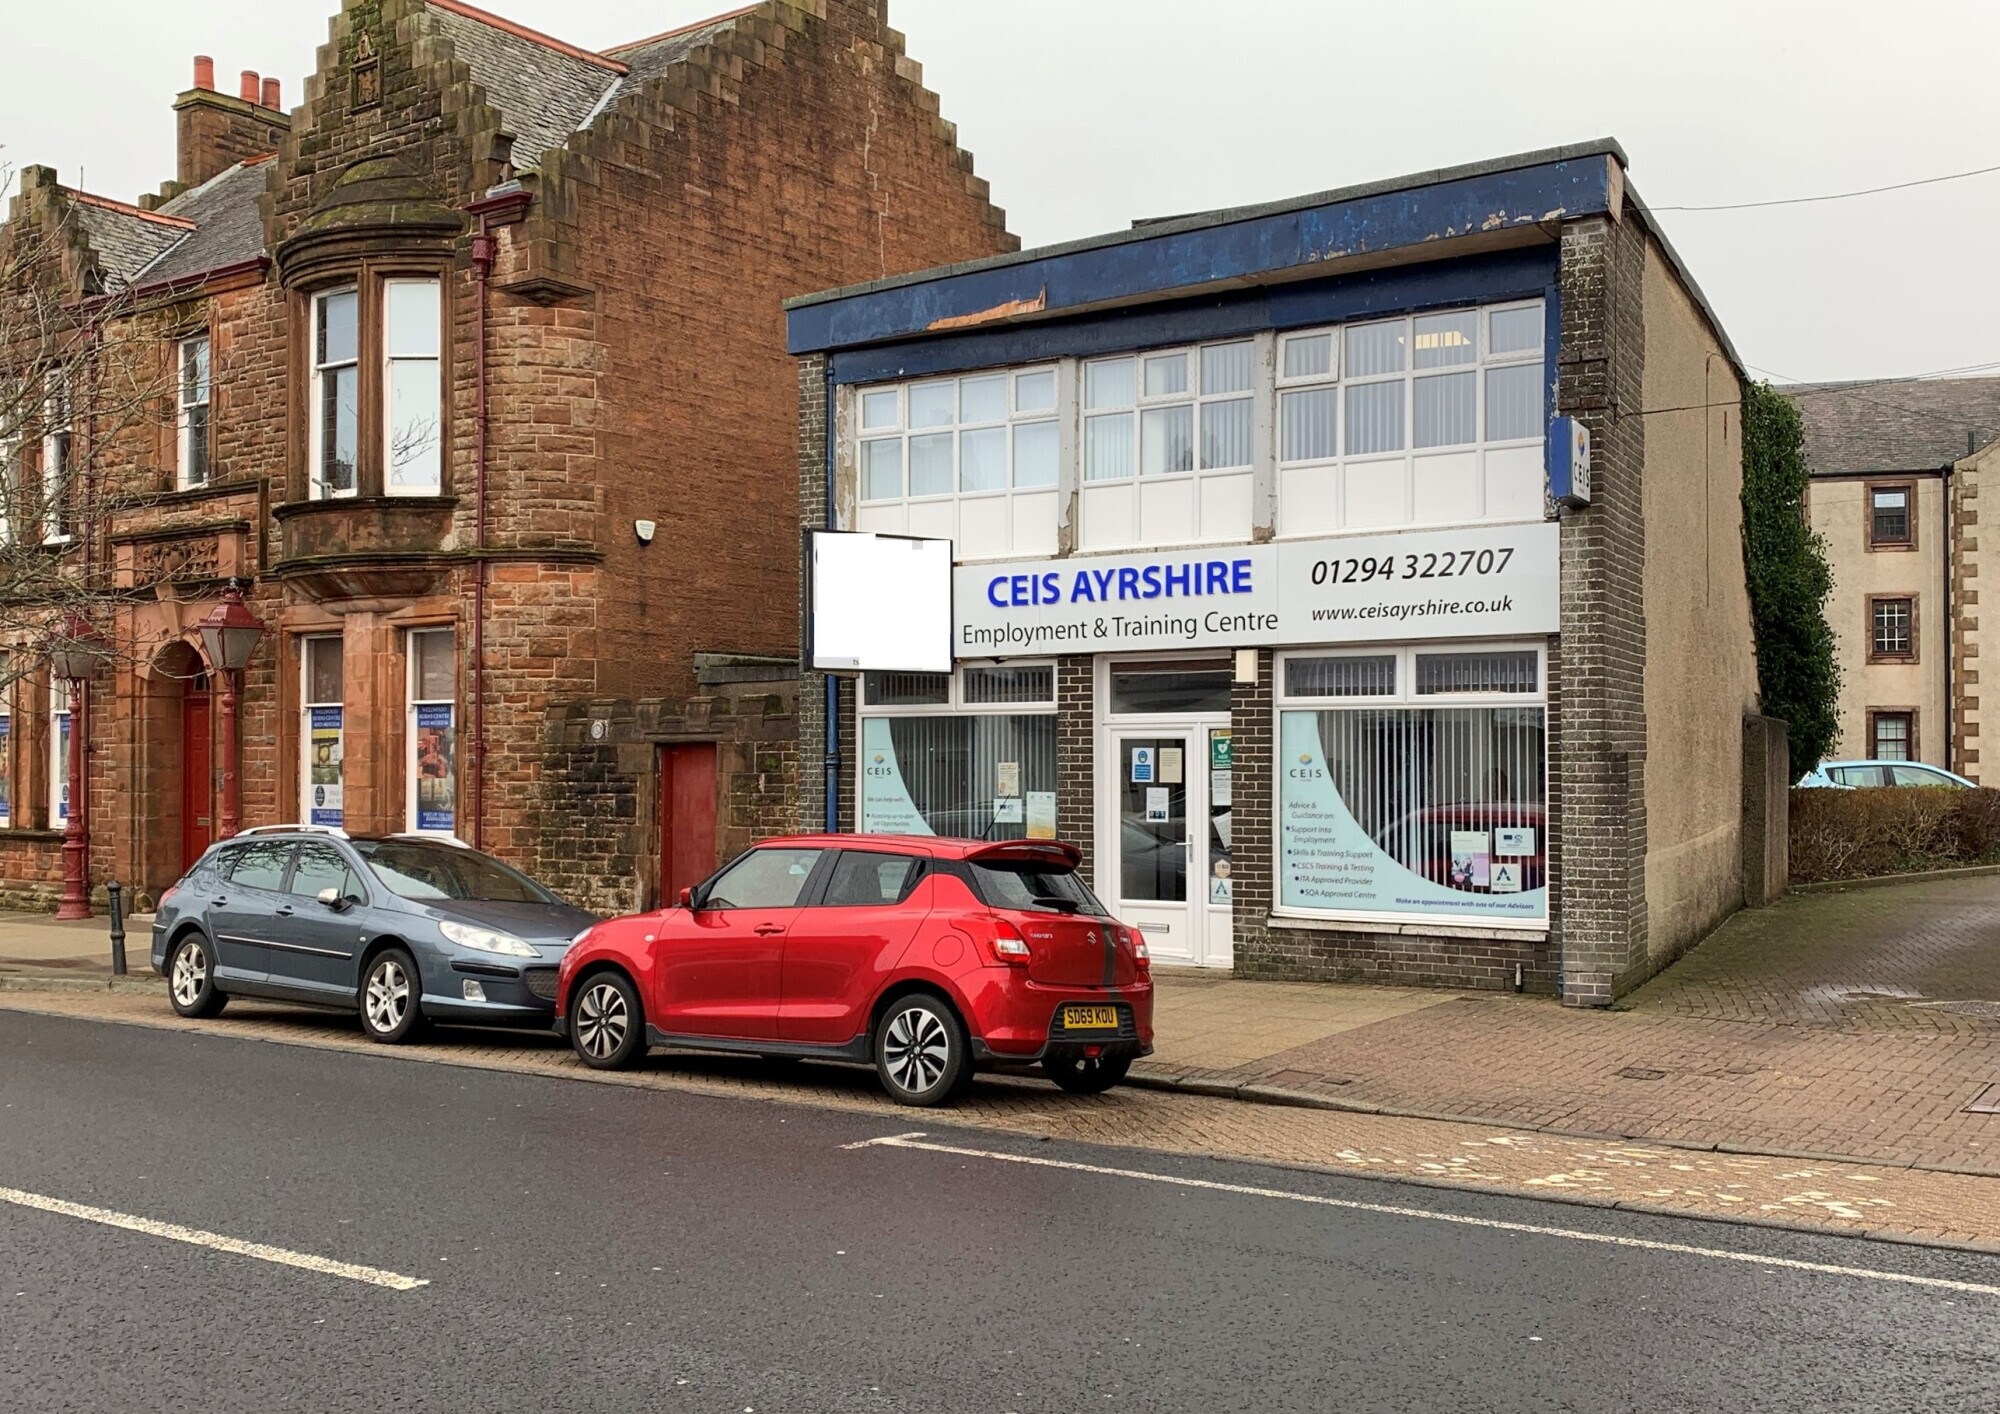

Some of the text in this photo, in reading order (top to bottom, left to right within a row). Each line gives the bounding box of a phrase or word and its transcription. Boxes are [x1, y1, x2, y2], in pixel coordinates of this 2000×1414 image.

[1573, 461, 1590, 488] CEIS
[1311, 548, 1515, 585] 01294 322707
[987, 559, 1253, 608] CEIS AYRSHIRE
[1311, 595, 1513, 621] www.ceisayrshire.co.uk
[963, 611, 1279, 648] Employment & Training Centre
[867, 767, 892, 775] CEIS
[1289, 769, 1322, 778] CEIS
[1288, 801, 1310, 809] Advice
[1291, 811, 1323, 819] Guidance
[1293, 835, 1336, 844] Employment
[1292, 848, 1309, 856] Skills
[1317, 849, 1344, 858] Training
[1345, 850, 1373, 859] Support
[1296, 862, 1314, 870] CSCS
[1315, 862, 1342, 872] Training
[1350, 863, 1375, 873] Testing
[1311, 876, 1343, 885] Approved
[1344, 877, 1373, 885] Provider
[1305, 889, 1377, 899] SQA Approved Centre
[1507, 902, 1534, 910] Advisors
[1067, 1008, 1114, 1025] SD69 KOU
